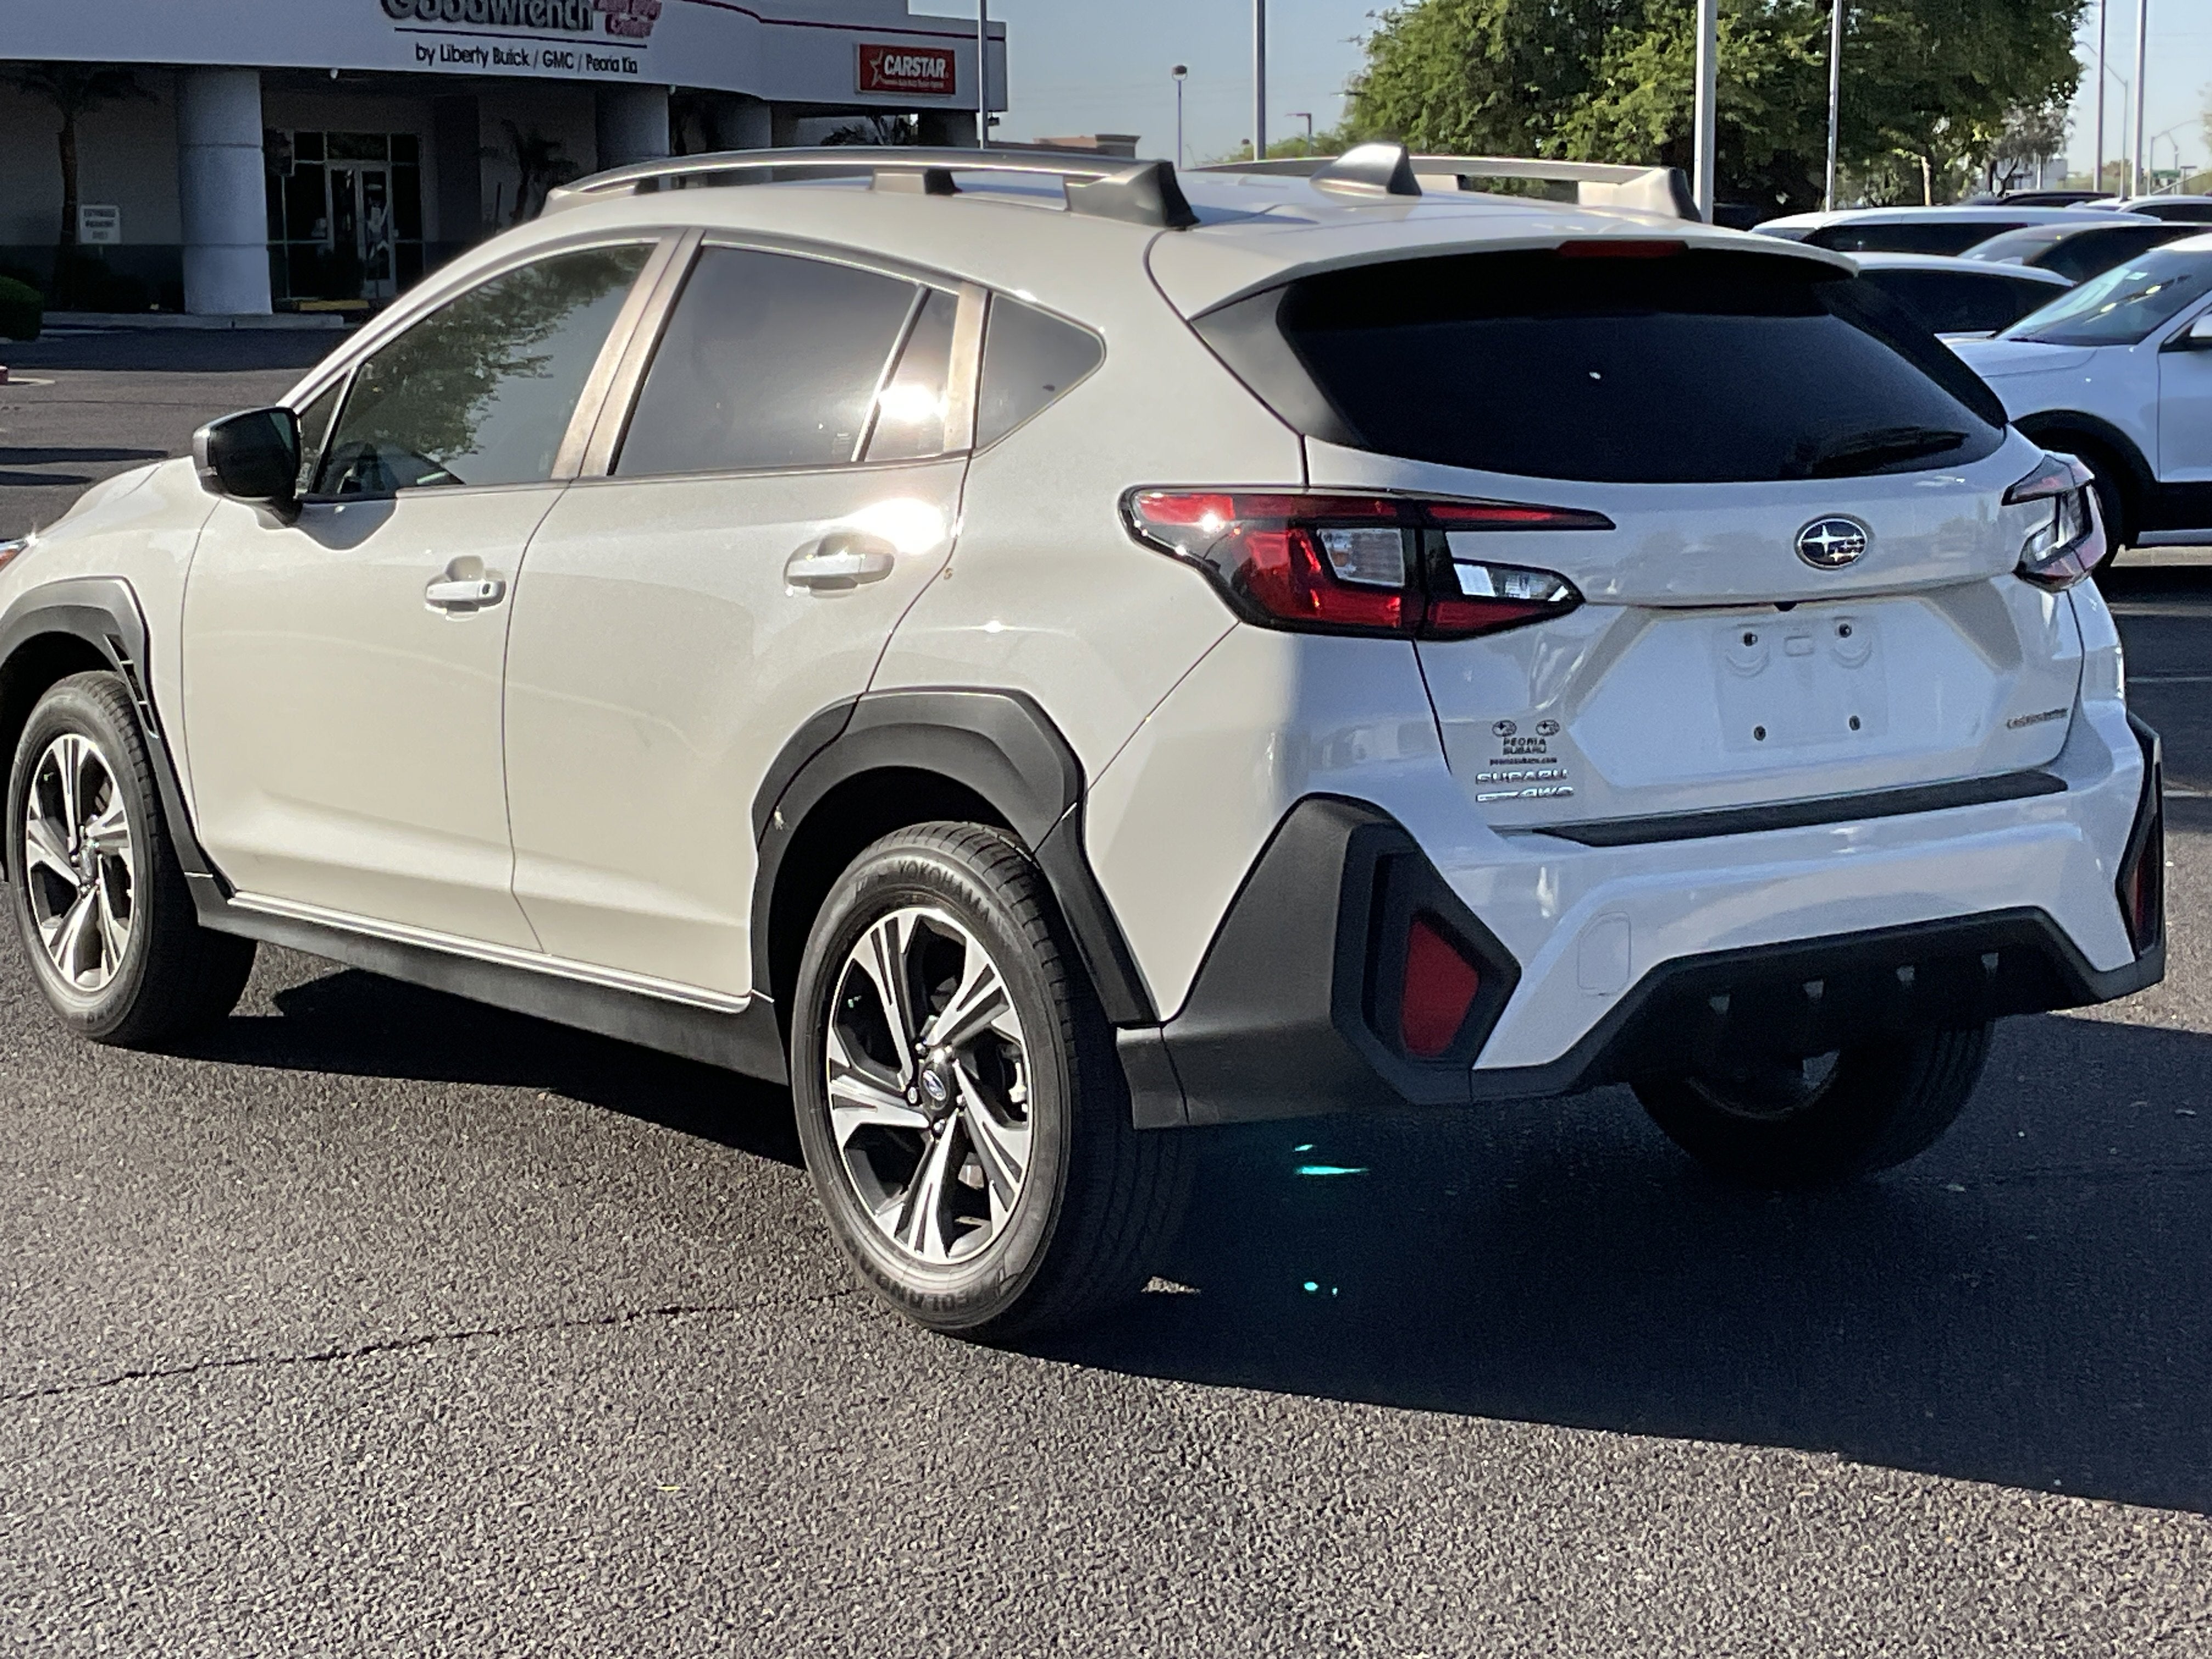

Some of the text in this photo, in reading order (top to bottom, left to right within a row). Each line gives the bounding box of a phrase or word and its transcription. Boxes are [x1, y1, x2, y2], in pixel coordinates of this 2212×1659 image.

[415, 43, 435, 66] by
[440, 44, 489, 69] Liberty
[493, 47, 531, 67] Buick
[543, 50, 574, 69] GMC
[586, 54, 620, 73] Peoria
[622, 56, 638, 74] Kia
[884, 54, 946, 78] CARSTAR
[1503, 737, 1547, 746] PEORIA
